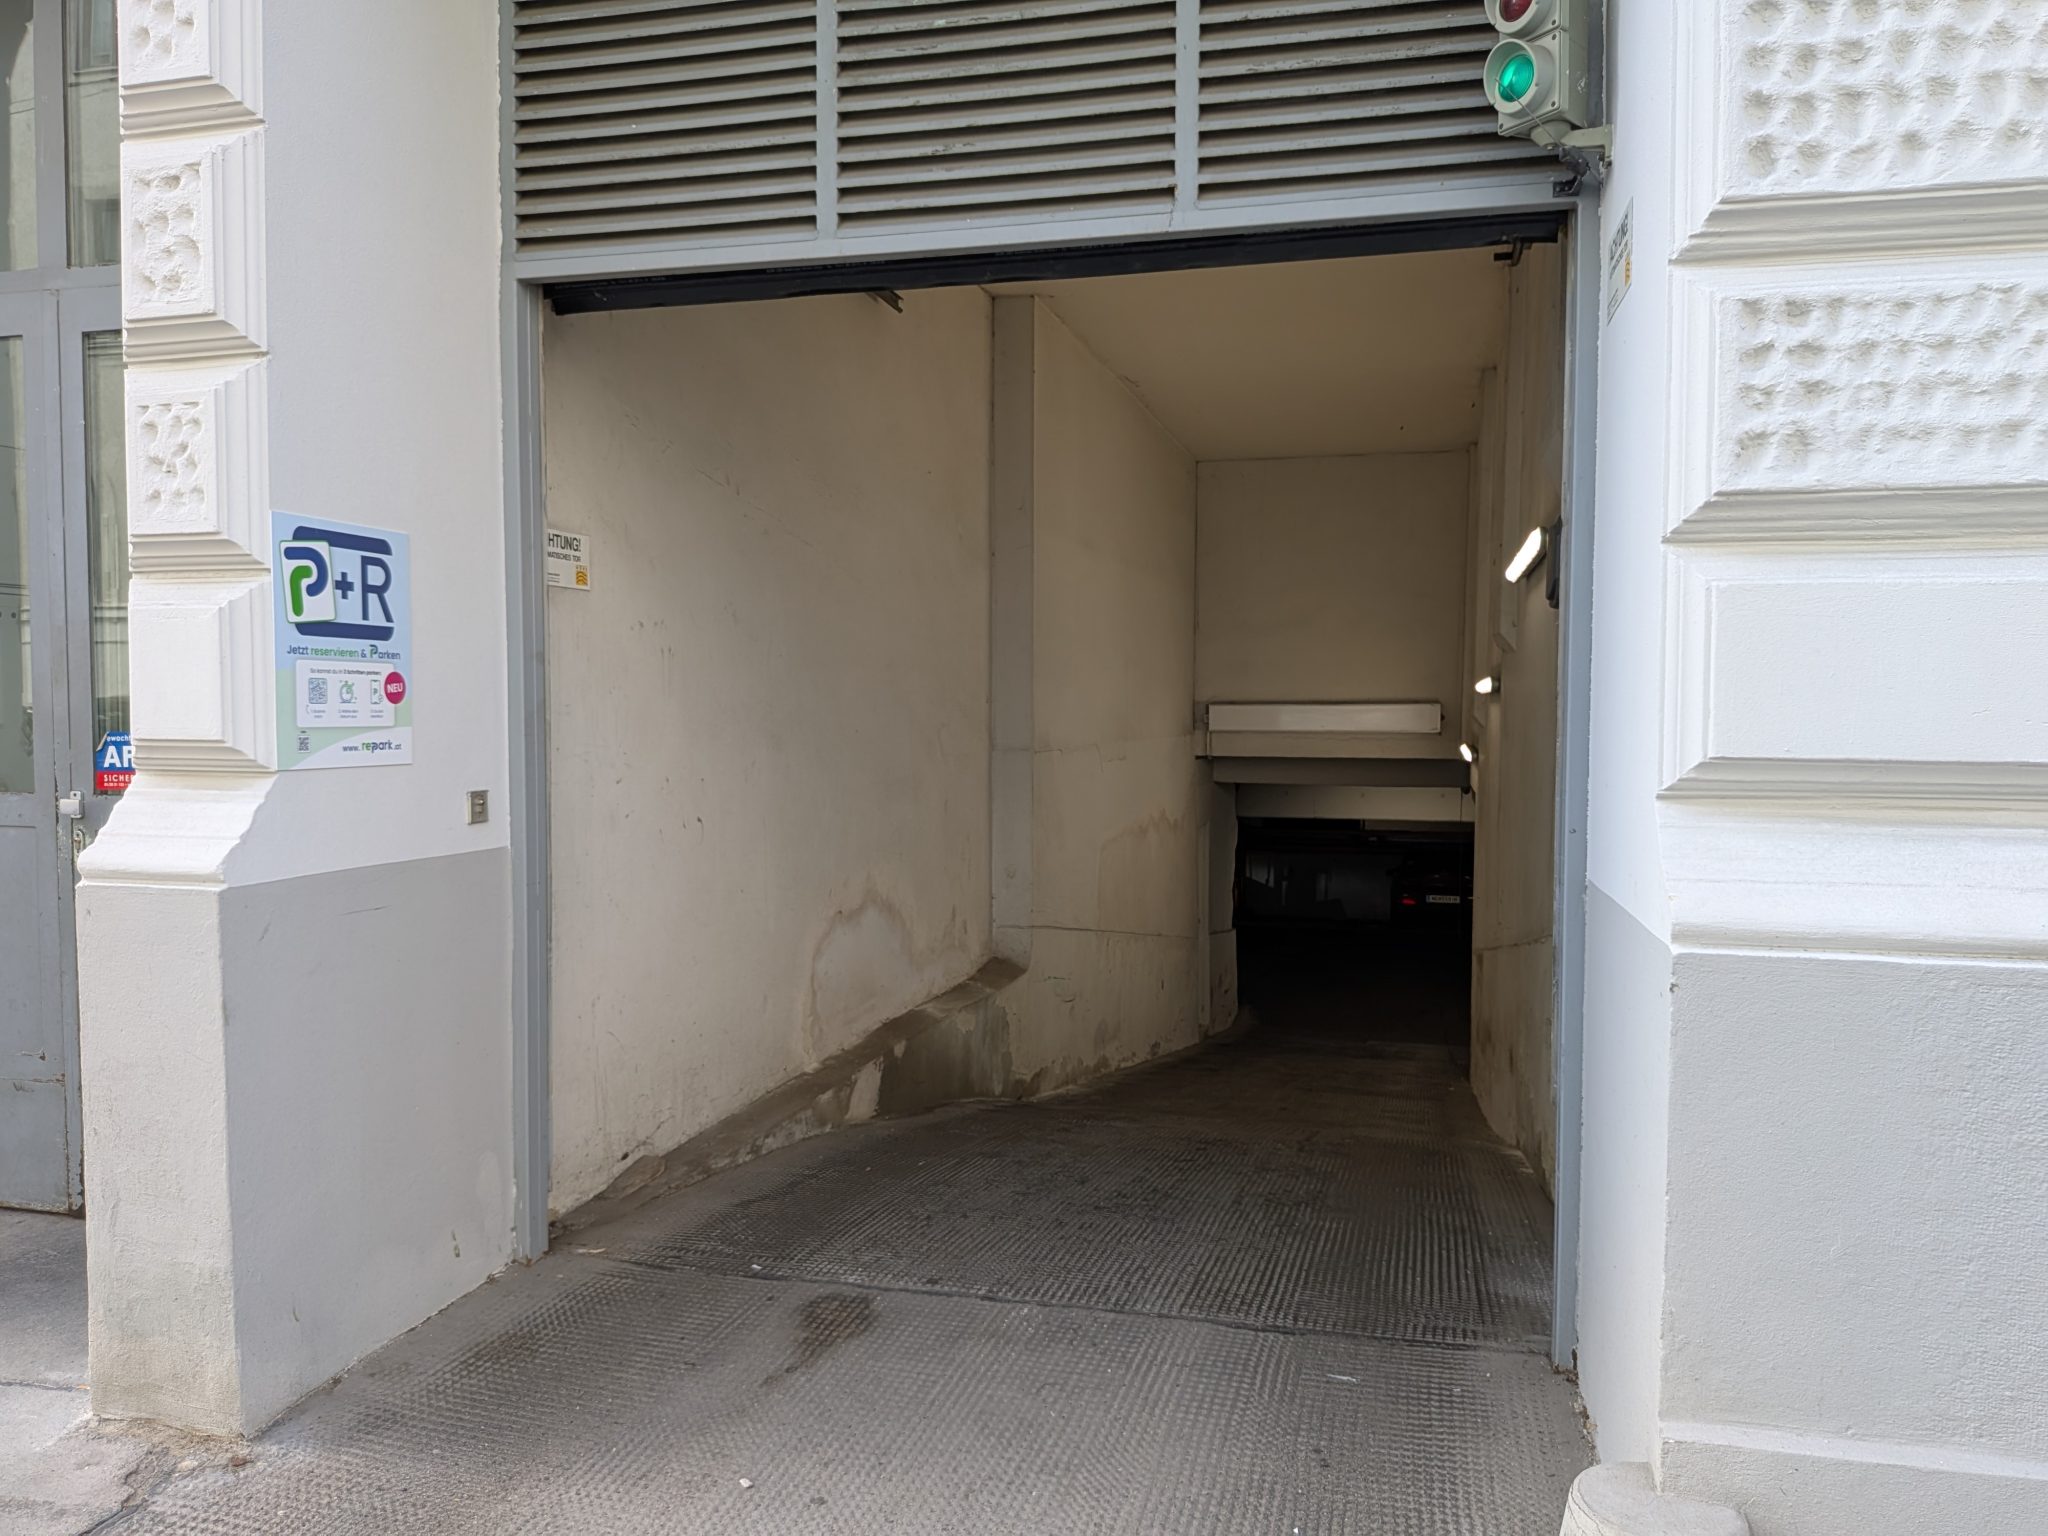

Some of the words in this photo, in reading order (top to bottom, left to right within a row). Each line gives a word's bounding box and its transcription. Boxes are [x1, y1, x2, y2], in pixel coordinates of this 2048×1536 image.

[287, 645, 309, 655] Jetzt
[311, 646, 359, 658] reservieren
[360, 649, 367, 658] &
[369, 644, 401, 659] Parken
[387, 682, 403, 693] NEU
